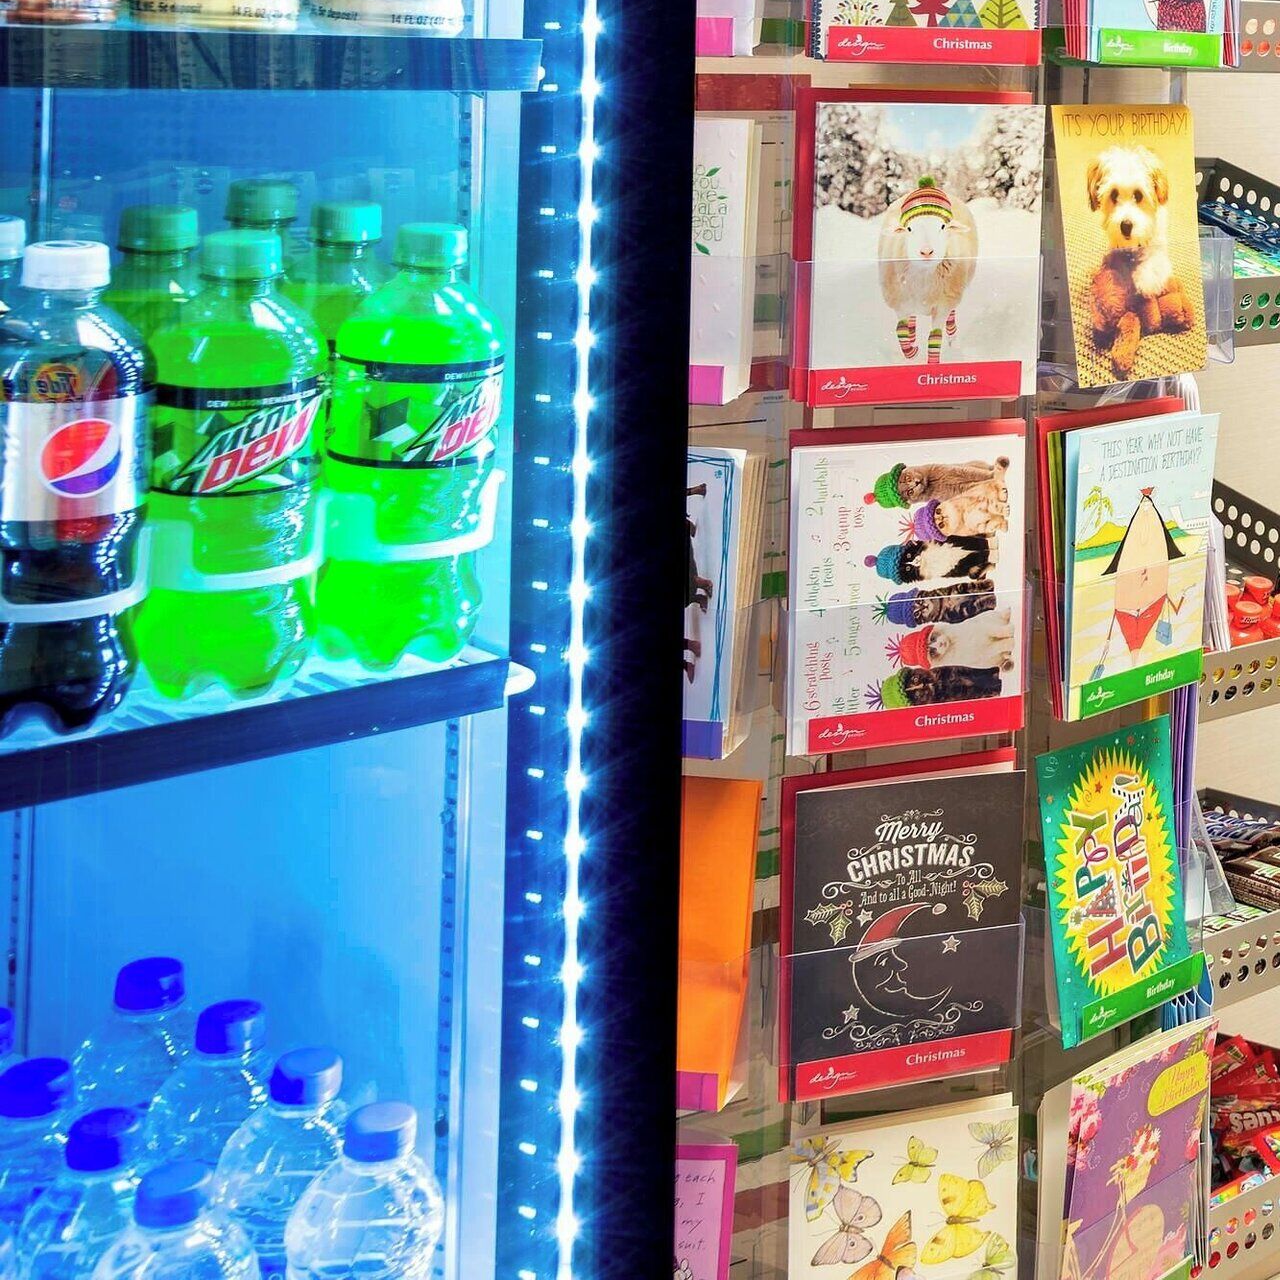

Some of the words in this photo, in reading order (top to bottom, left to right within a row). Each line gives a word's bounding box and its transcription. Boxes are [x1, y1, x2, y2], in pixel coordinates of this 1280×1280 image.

[933, 37, 992, 52] Christmas
[1163, 41, 1195, 58] Birthday
[1061, 114, 1081, 137] IT'S
[1090, 114, 1125, 137] YOUR
[1131, 110, 1192, 136] BIRTHDAY!
[917, 373, 977, 387] Christmas
[1101, 440, 1122, 458] THIS
[1145, 669, 1175, 686] Birthday
[915, 711, 975, 728] Christmas
[876, 820, 943, 842] Merry
[846, 843, 975, 882] CHRISTMAS
[897, 873, 907, 884] To
[909, 870, 922, 884] All
[1147, 978, 1176, 997] Birthday
[907, 1048, 966, 1065] Christmas
